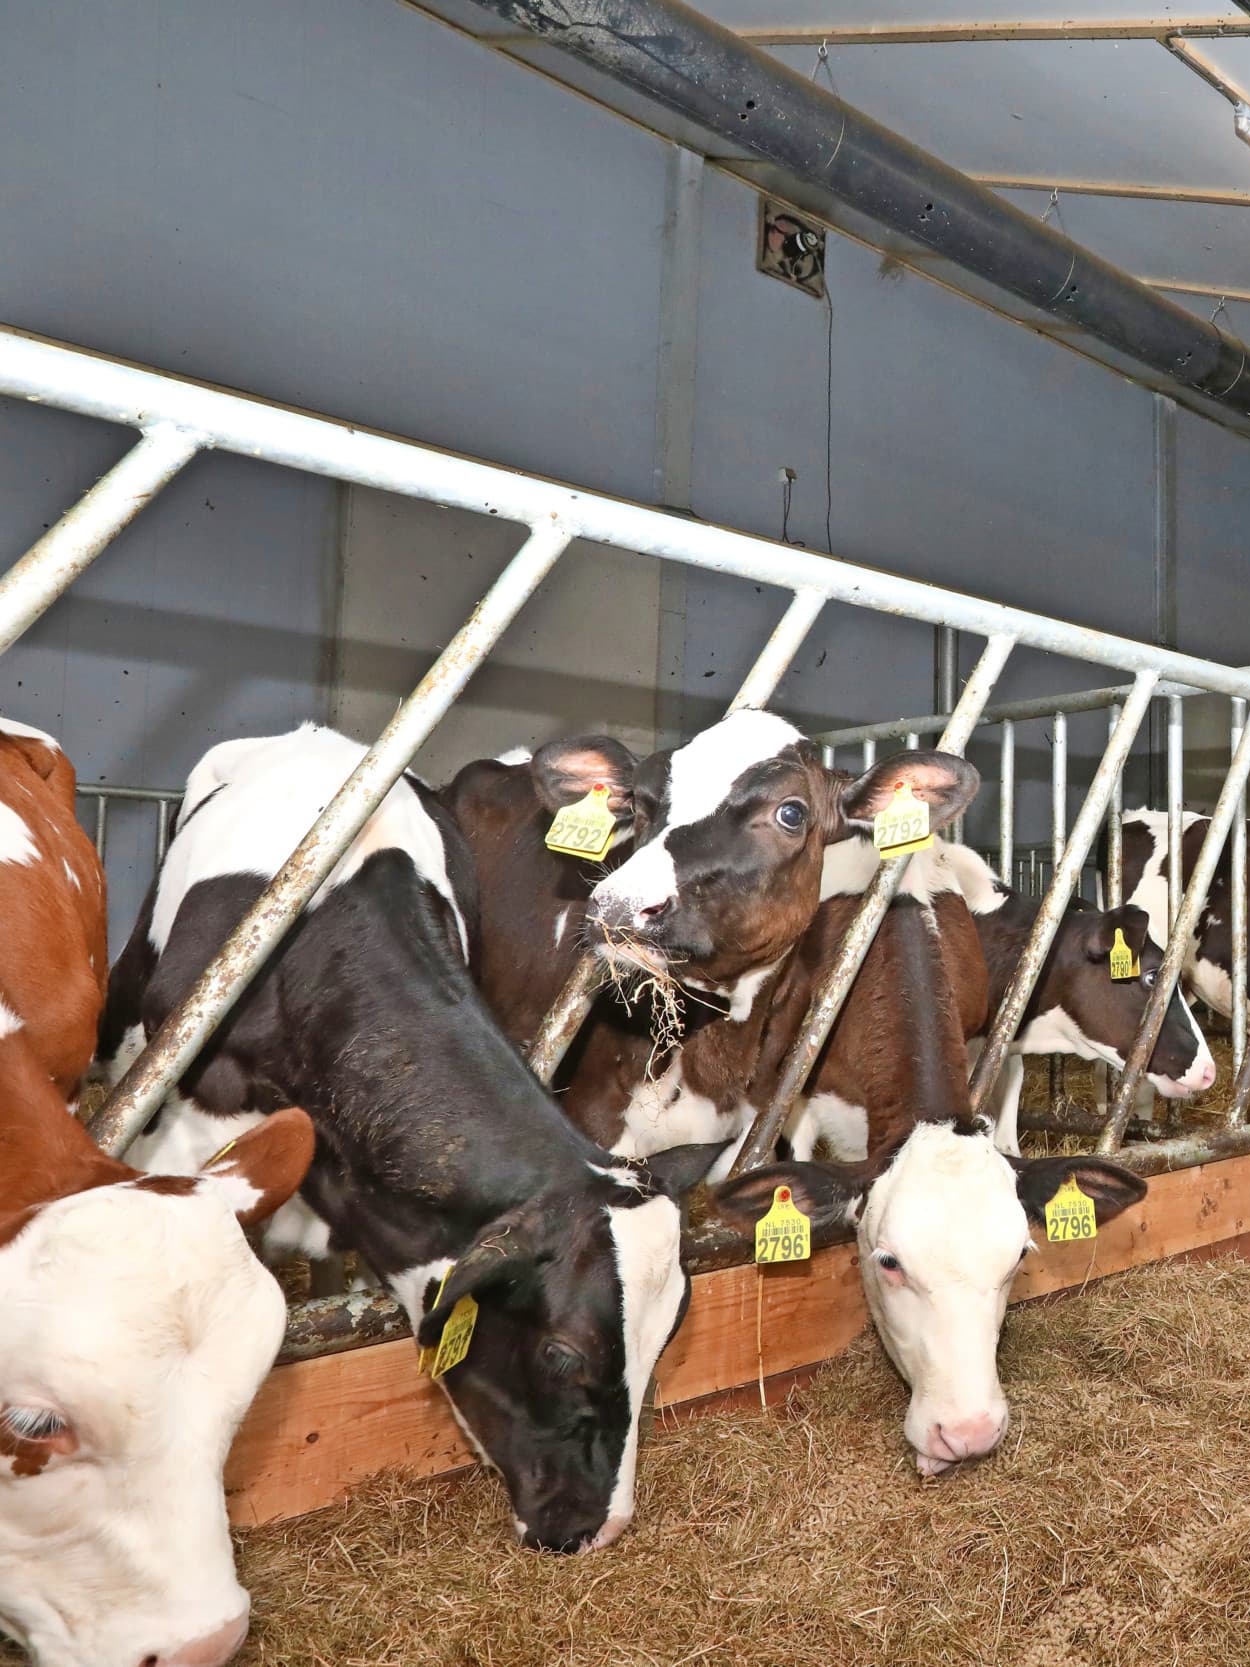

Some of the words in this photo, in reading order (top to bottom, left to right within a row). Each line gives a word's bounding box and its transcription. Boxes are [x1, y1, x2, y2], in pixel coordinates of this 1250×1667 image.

[546, 822, 602, 850] 2792
[876, 817, 923, 847] 2792
[1049, 1214, 1092, 1241] 2796
[757, 1233, 804, 1262] 2796
